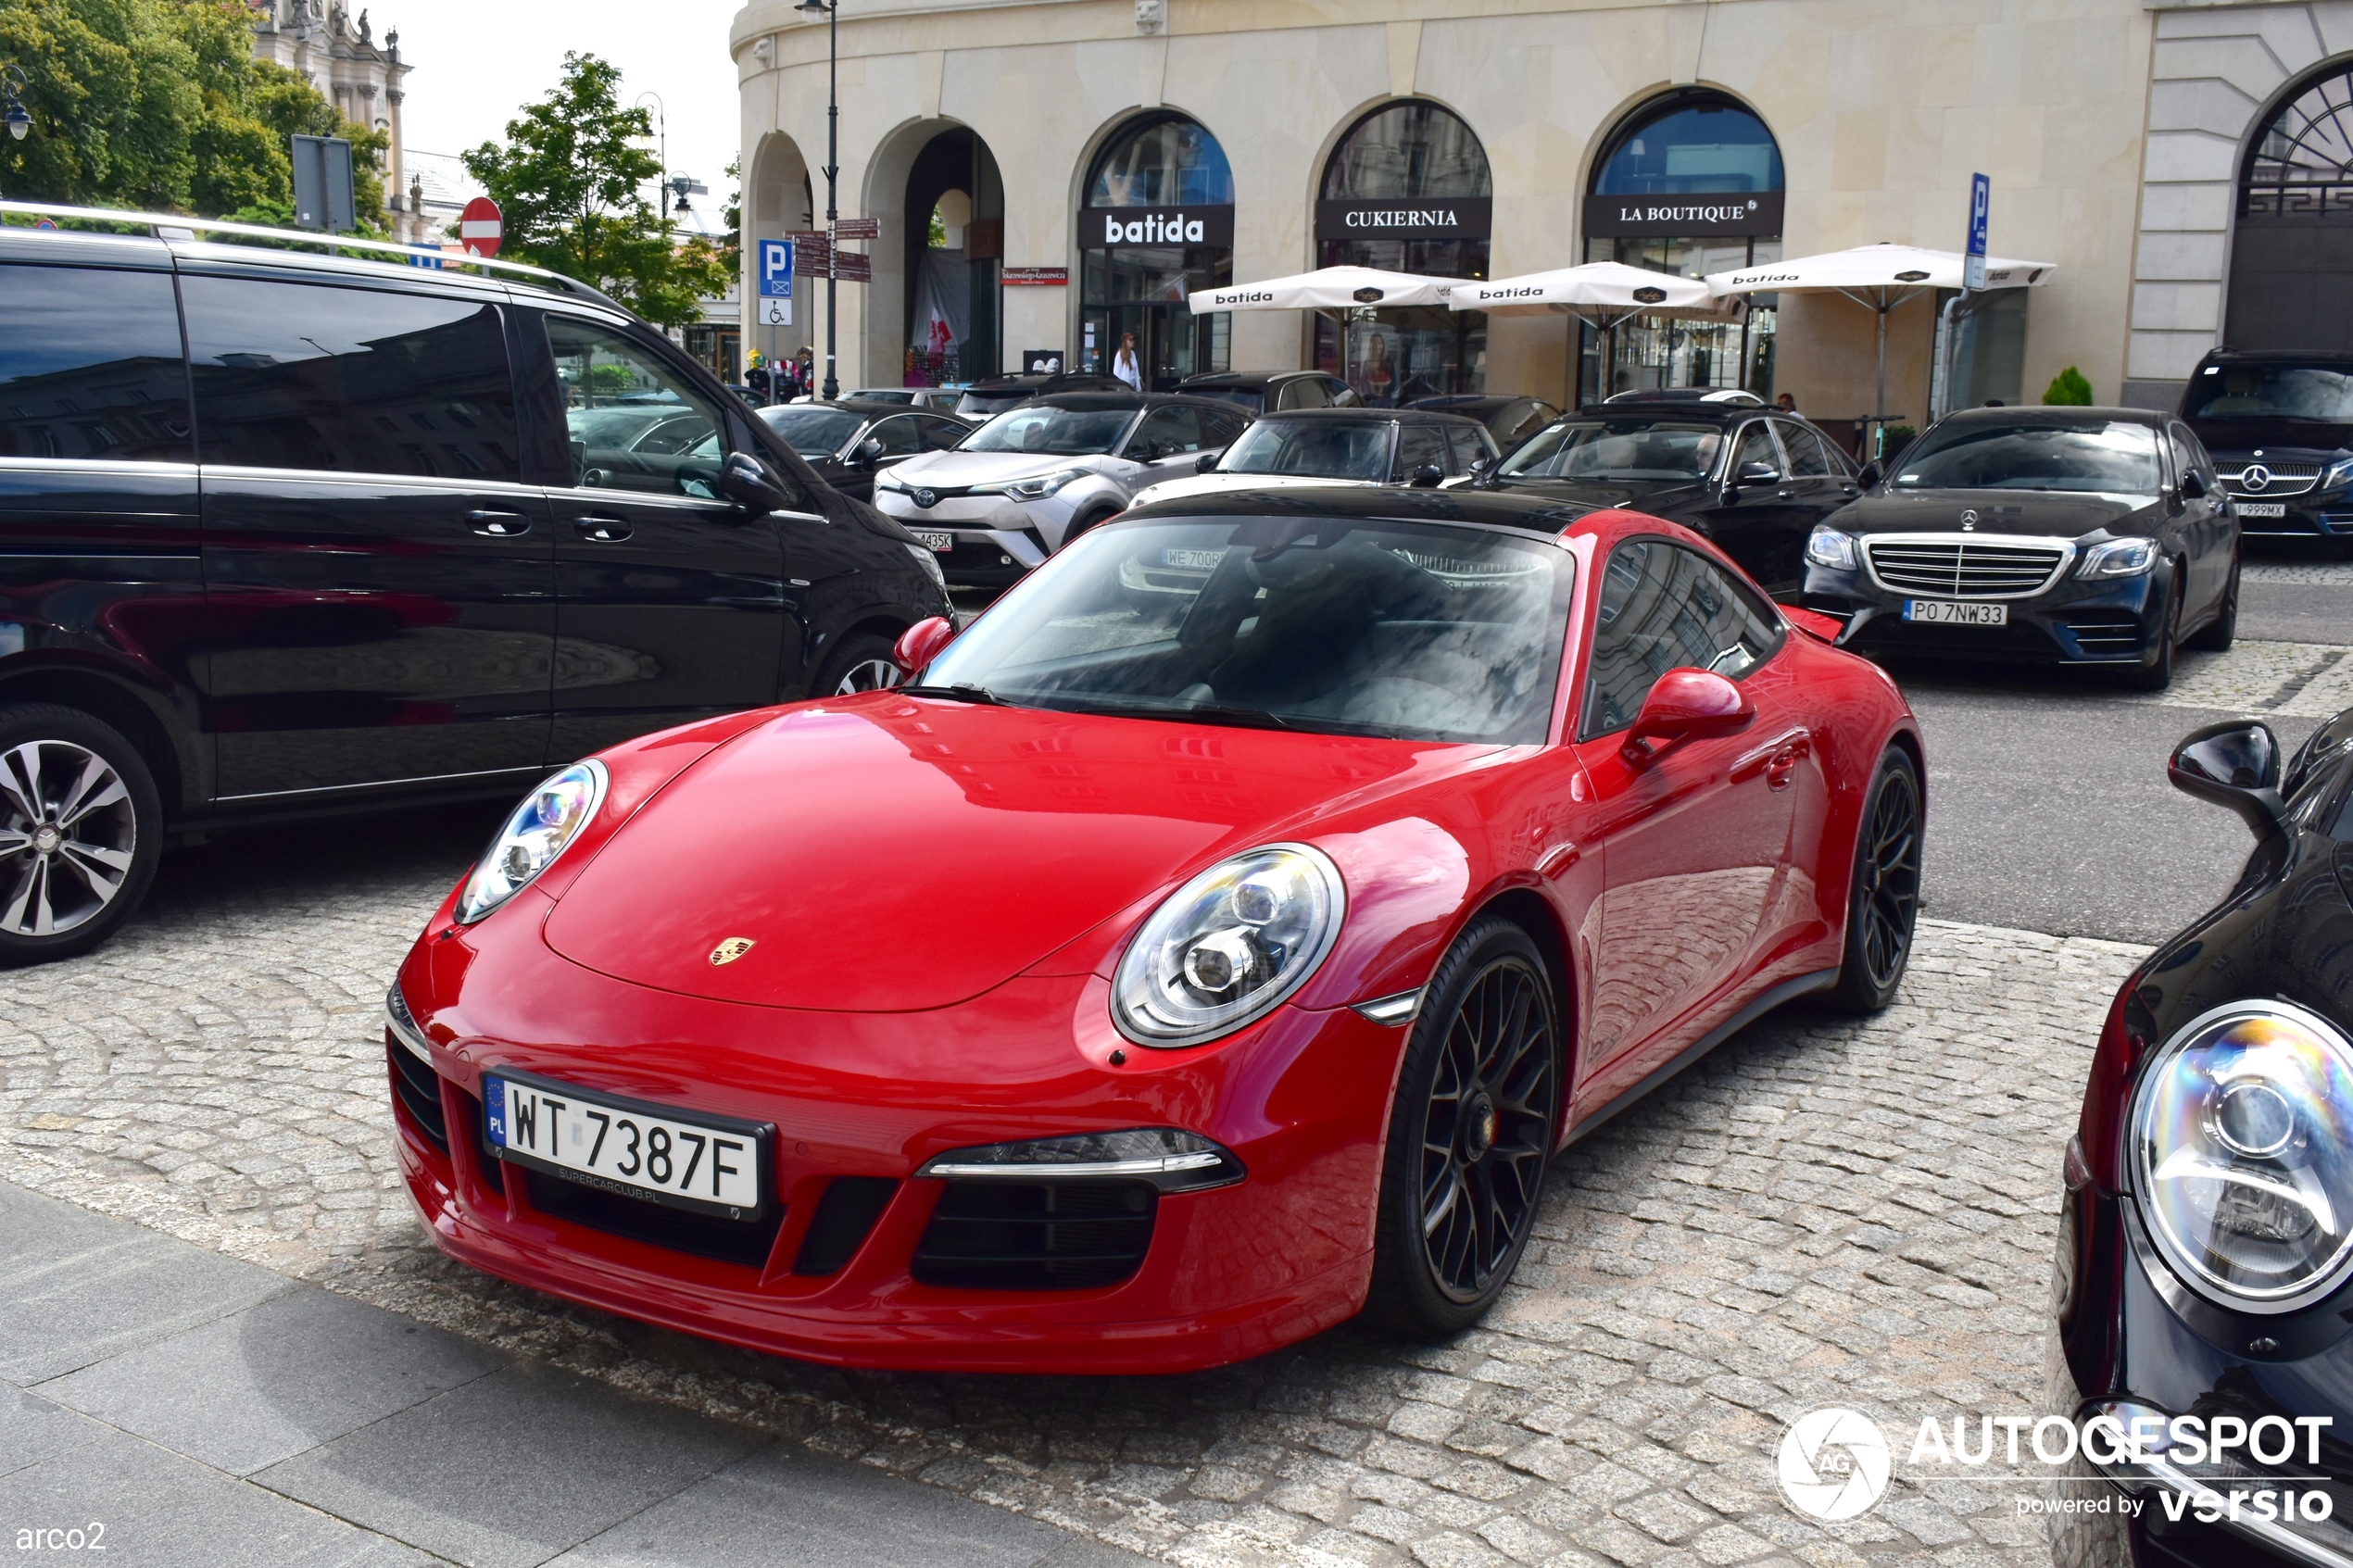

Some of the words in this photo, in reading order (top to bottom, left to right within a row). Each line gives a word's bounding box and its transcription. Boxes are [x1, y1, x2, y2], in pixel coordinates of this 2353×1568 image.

[1620, 207, 1642, 221] LA
[1646, 206, 1744, 223] BOUTIQUE
[1973, 181, 1987, 231] P
[1345, 209, 1458, 227] CUKIERNIA
[1105, 213, 1203, 243] batida
[766, 244, 786, 281] P
[1731, 274, 1800, 284] batida
[1215, 292, 1273, 304] batida
[1479, 287, 1544, 299] batida
[2246, 505, 2283, 516] 999MX
[1169, 550, 1186, 565] WE
[1189, 552, 1224, 566] 700R
[1944, 604, 2002, 623] 7NW33
[490, 1116, 505, 1135] PL
[513, 1089, 566, 1157] WT
[586, 1110, 743, 1197] 7387F
[559, 1168, 660, 1202] SUPERCARCLUB.PL
